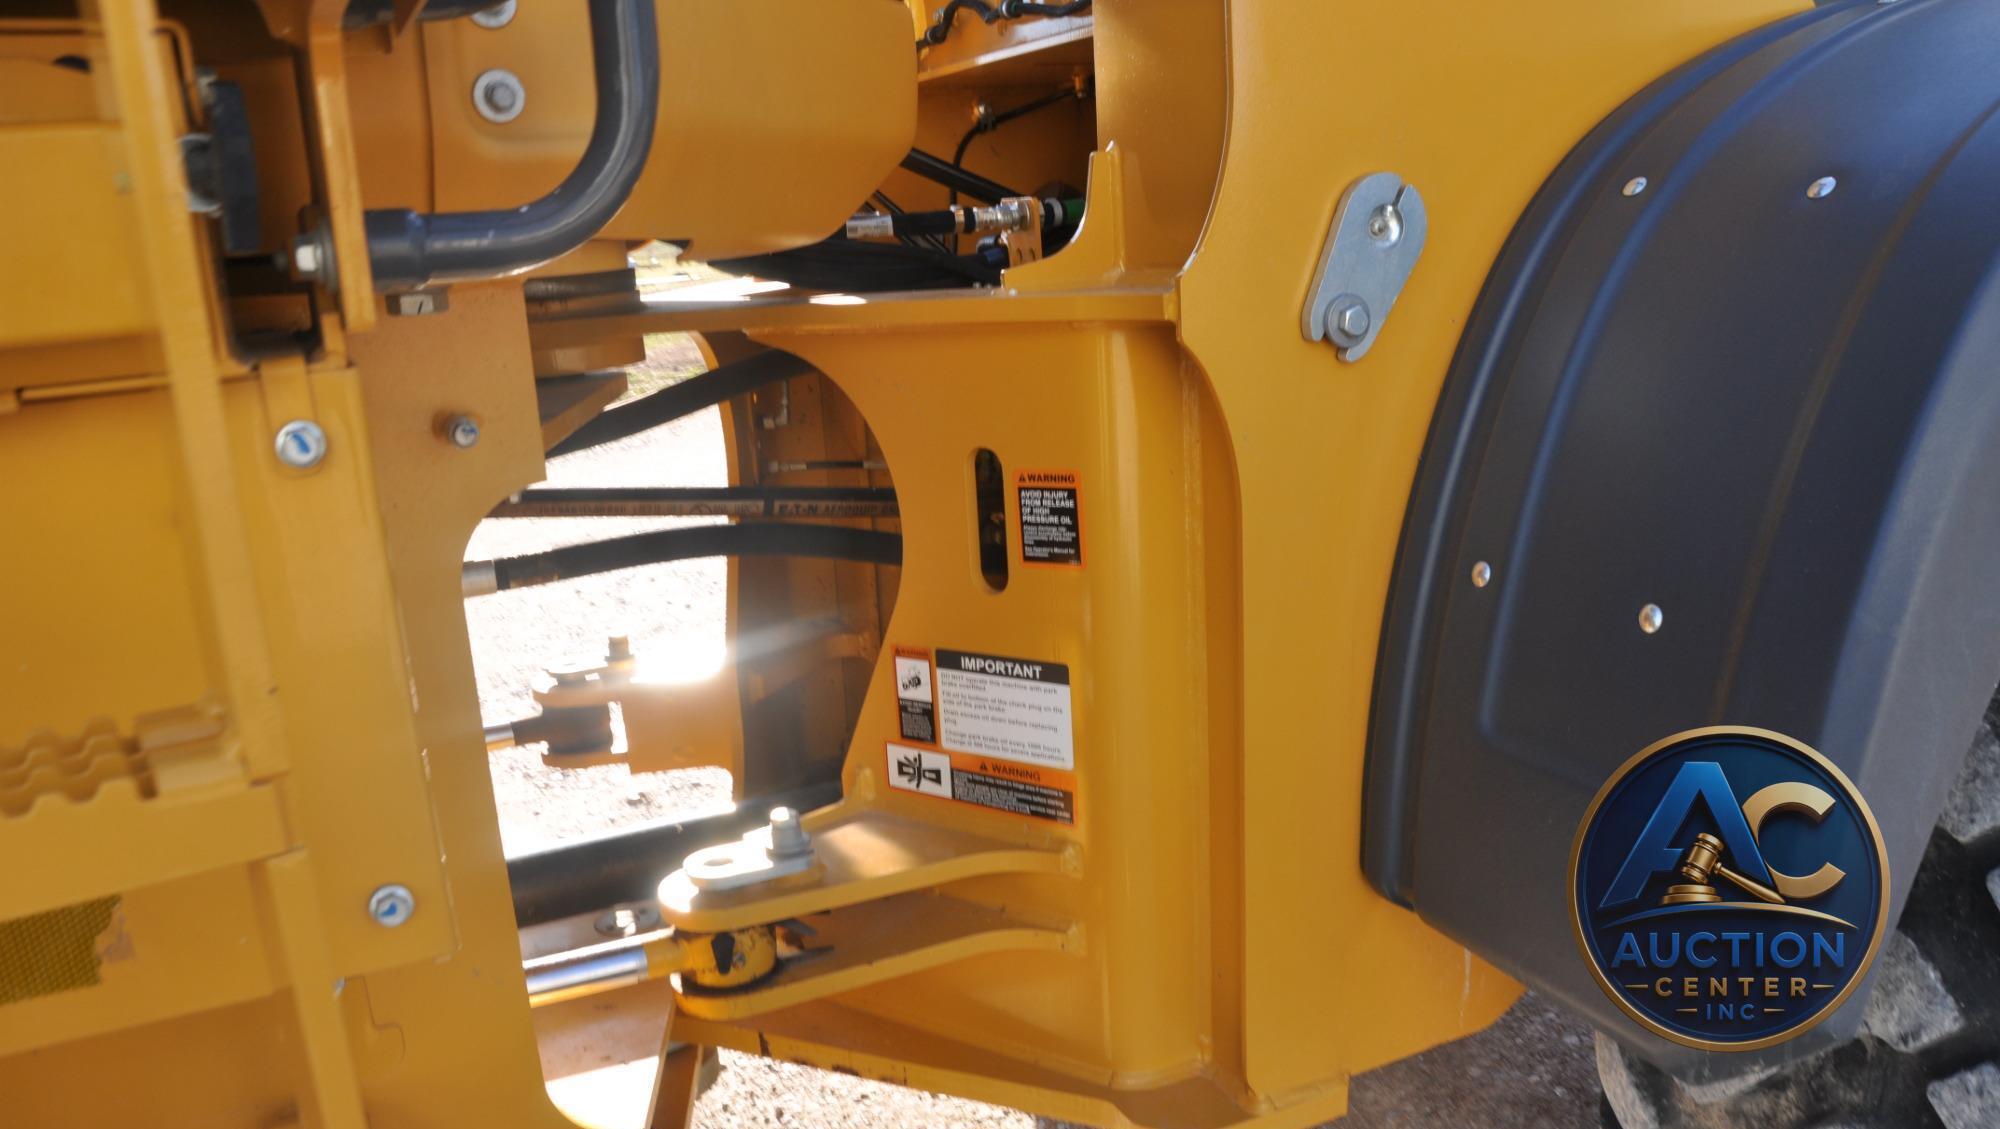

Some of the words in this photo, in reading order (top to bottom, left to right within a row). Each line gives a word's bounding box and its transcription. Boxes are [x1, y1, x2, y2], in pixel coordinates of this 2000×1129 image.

[1027, 472, 1075, 483] WARNING
[1021, 489, 1042, 498] AVOID
[1043, 490, 1068, 499] INJURY
[1021, 498, 1041, 507] FROM
[1043, 499, 1074, 508] RELEASE
[1022, 507, 1031, 515] OF
[1033, 507, 1050, 515] HIGH
[1023, 515, 1059, 524] PRESSURE
[1061, 516, 1072, 525] OIL
[961, 656, 1042, 679] IMPORTANT
[991, 763, 1041, 781] WARNING
